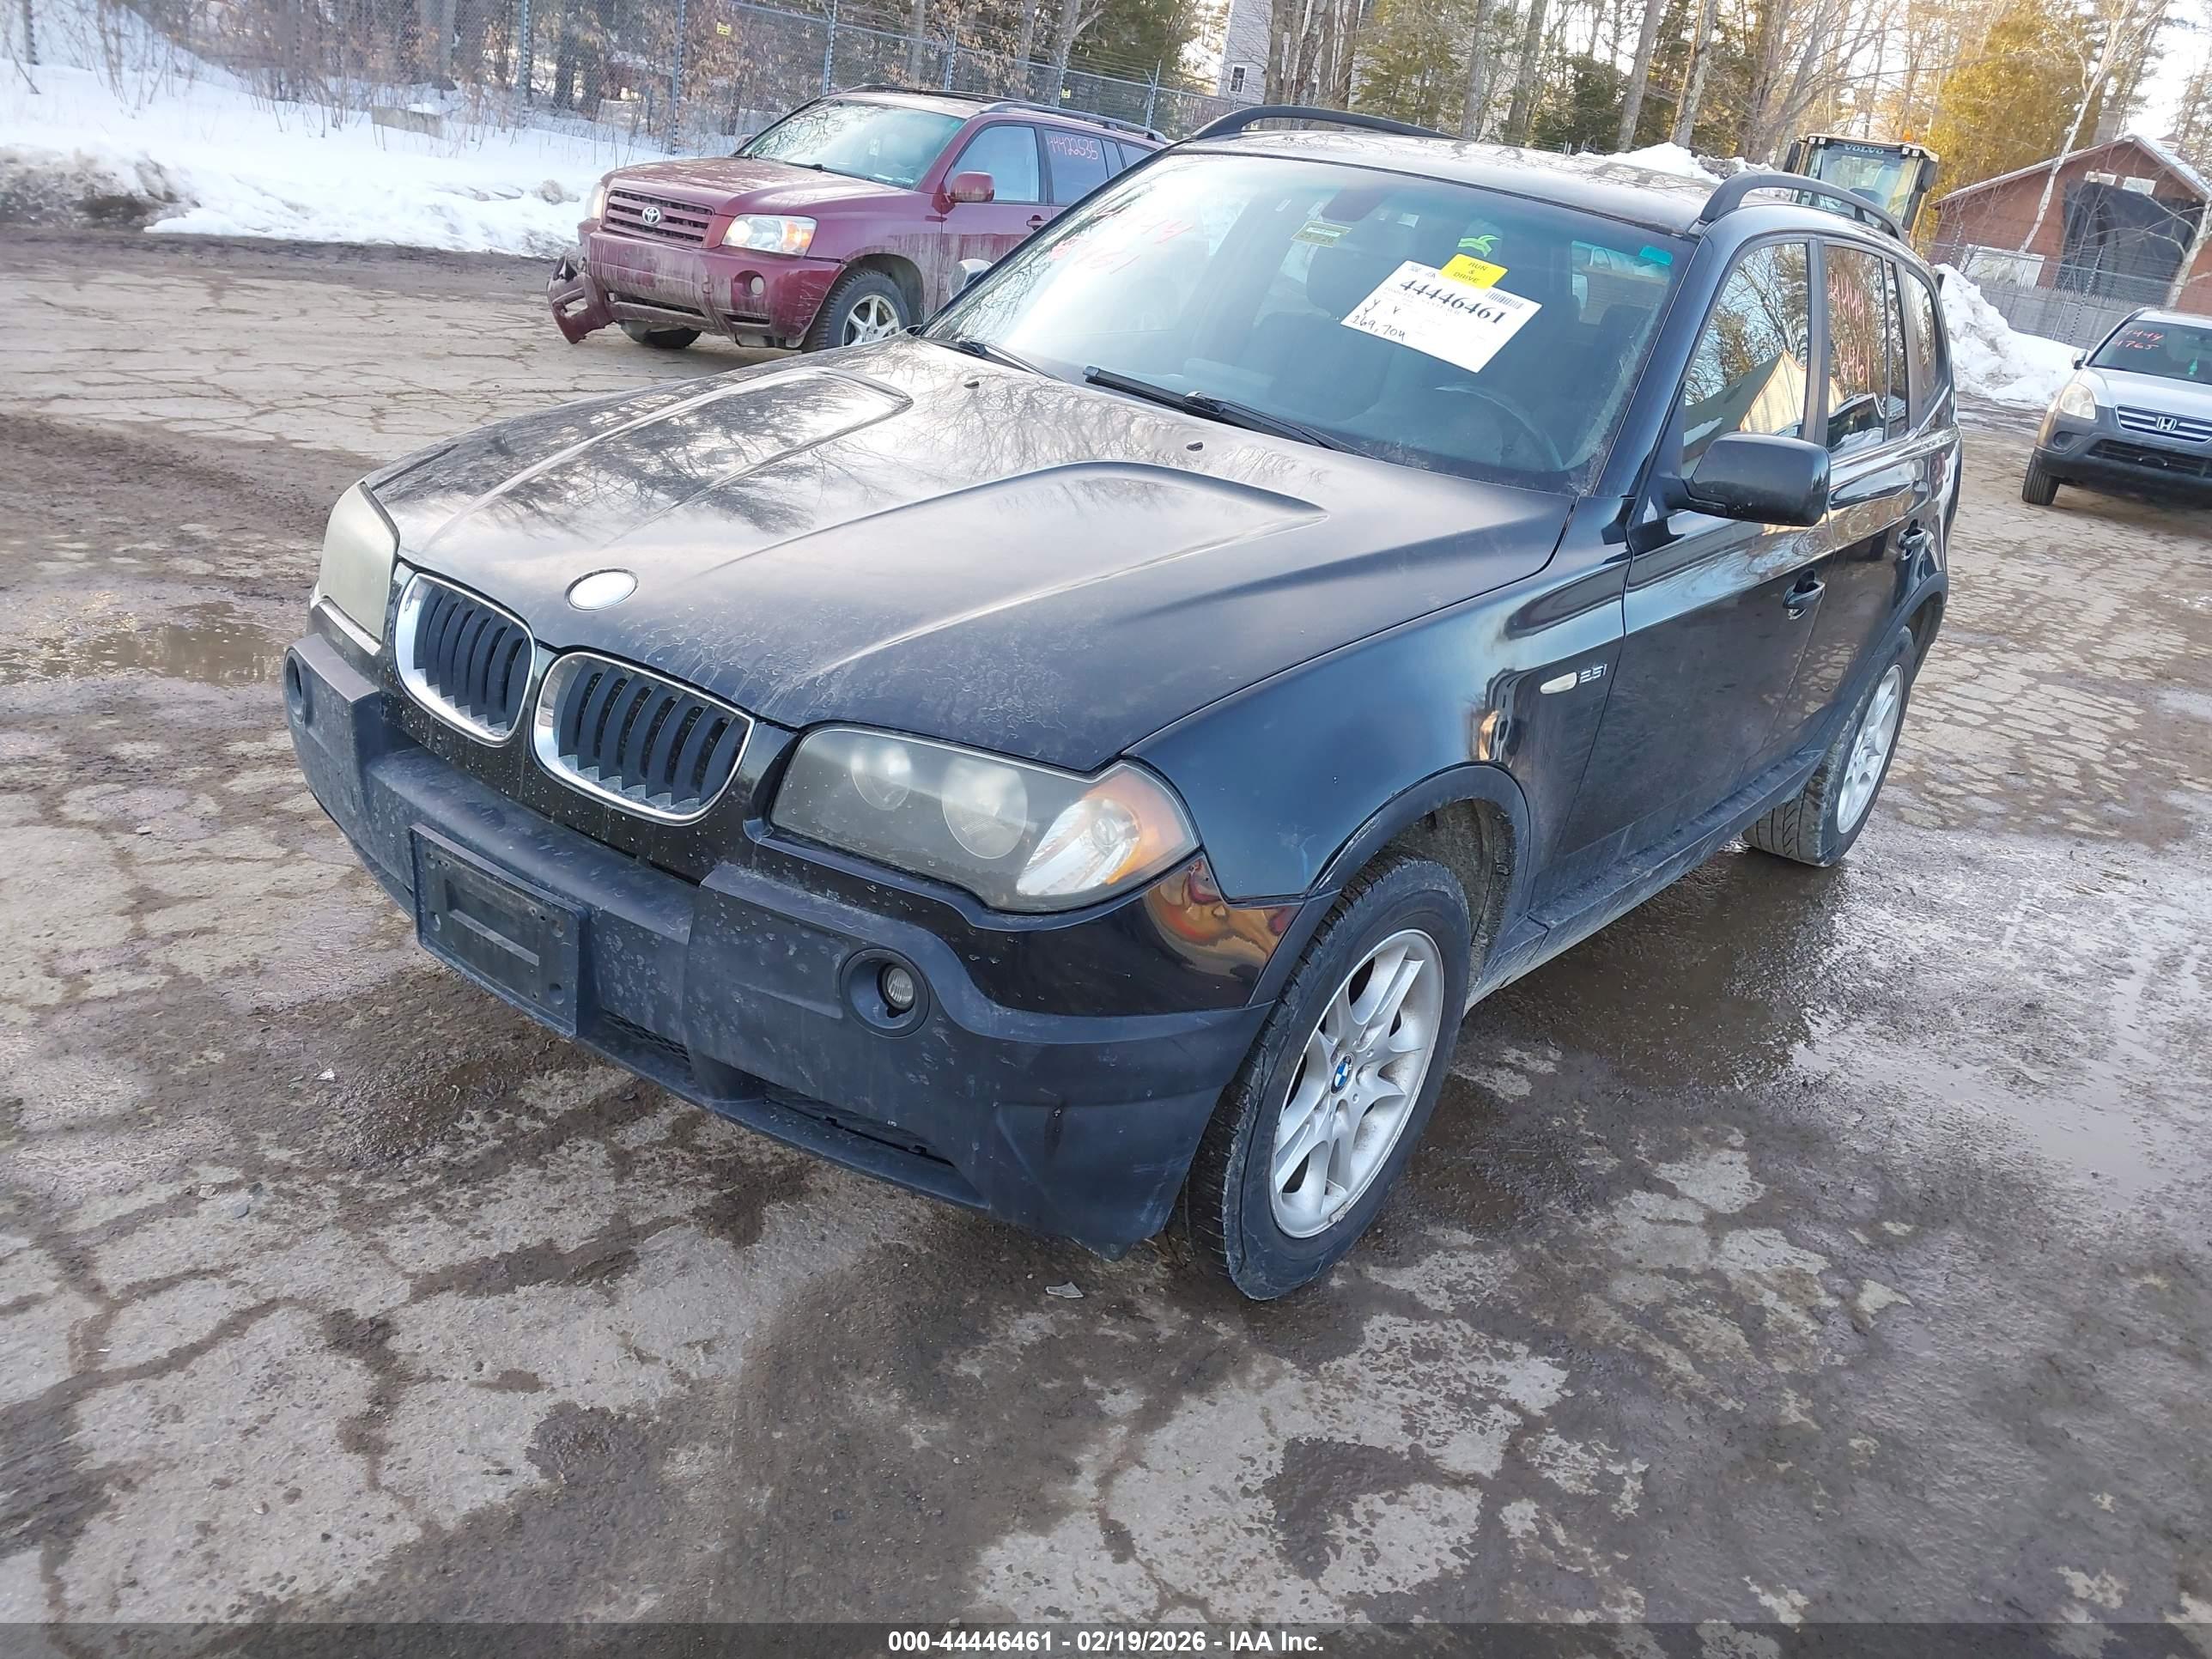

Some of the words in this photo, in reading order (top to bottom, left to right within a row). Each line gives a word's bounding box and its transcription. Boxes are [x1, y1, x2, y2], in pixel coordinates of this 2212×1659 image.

[1844, 143, 1885, 155] VOLVO
[1468, 261, 1489, 271] RUN
[1453, 271, 1480, 283] DRIVE
[1400, 280, 1506, 325] 44446461
